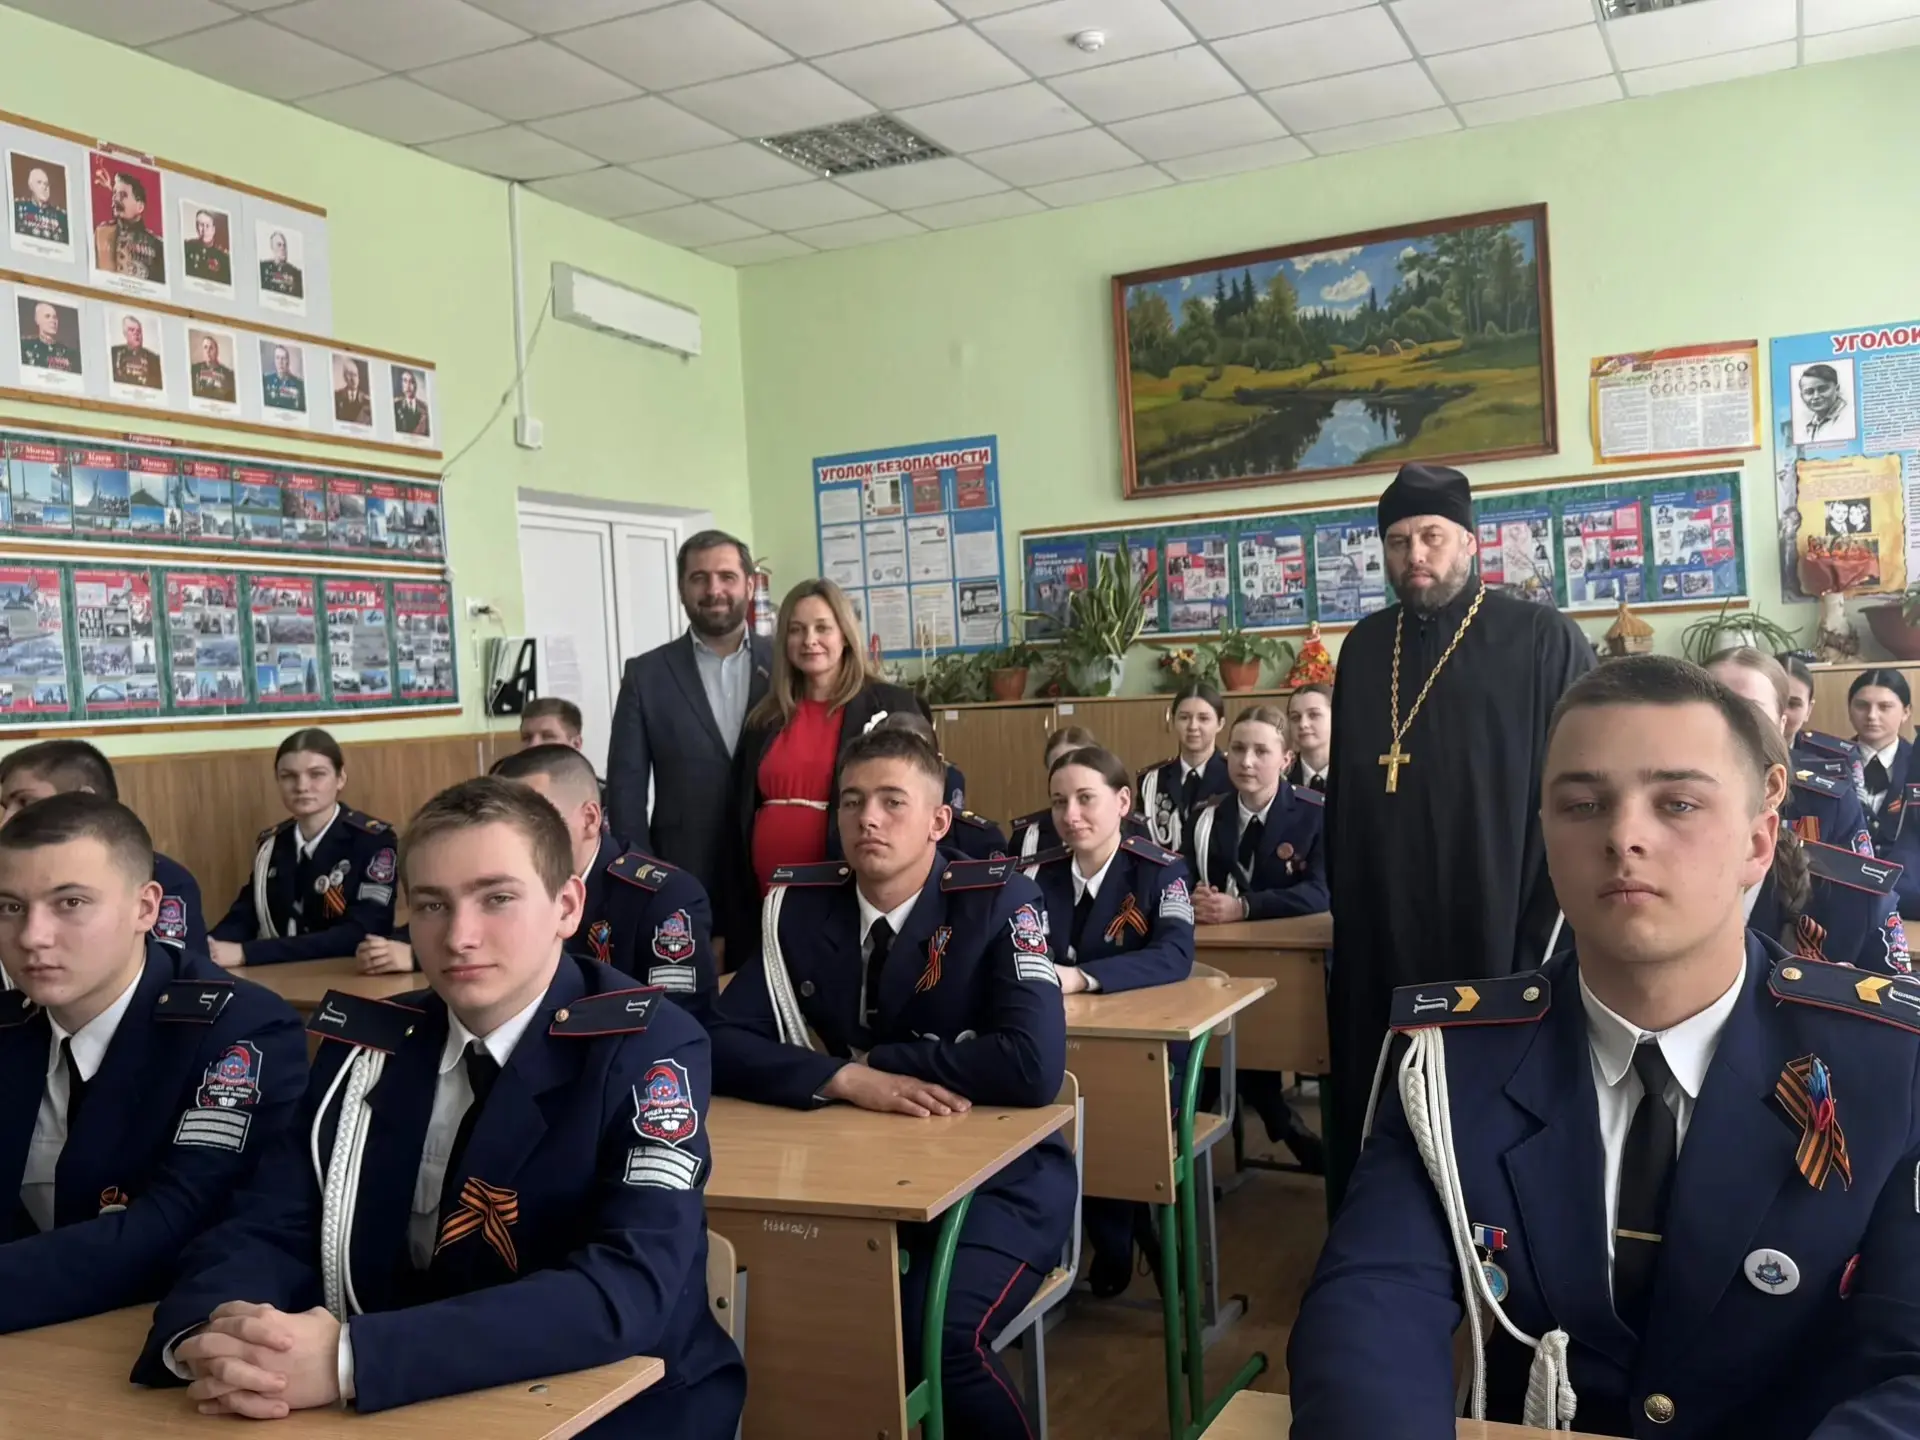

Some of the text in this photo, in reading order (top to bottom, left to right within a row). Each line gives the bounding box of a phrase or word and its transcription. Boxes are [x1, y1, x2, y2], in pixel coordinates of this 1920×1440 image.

[1833, 328, 1920, 352] УГОЛОК
[820, 449, 989, 481] УГОЛОК БЕЗОПАСНОСТИ
